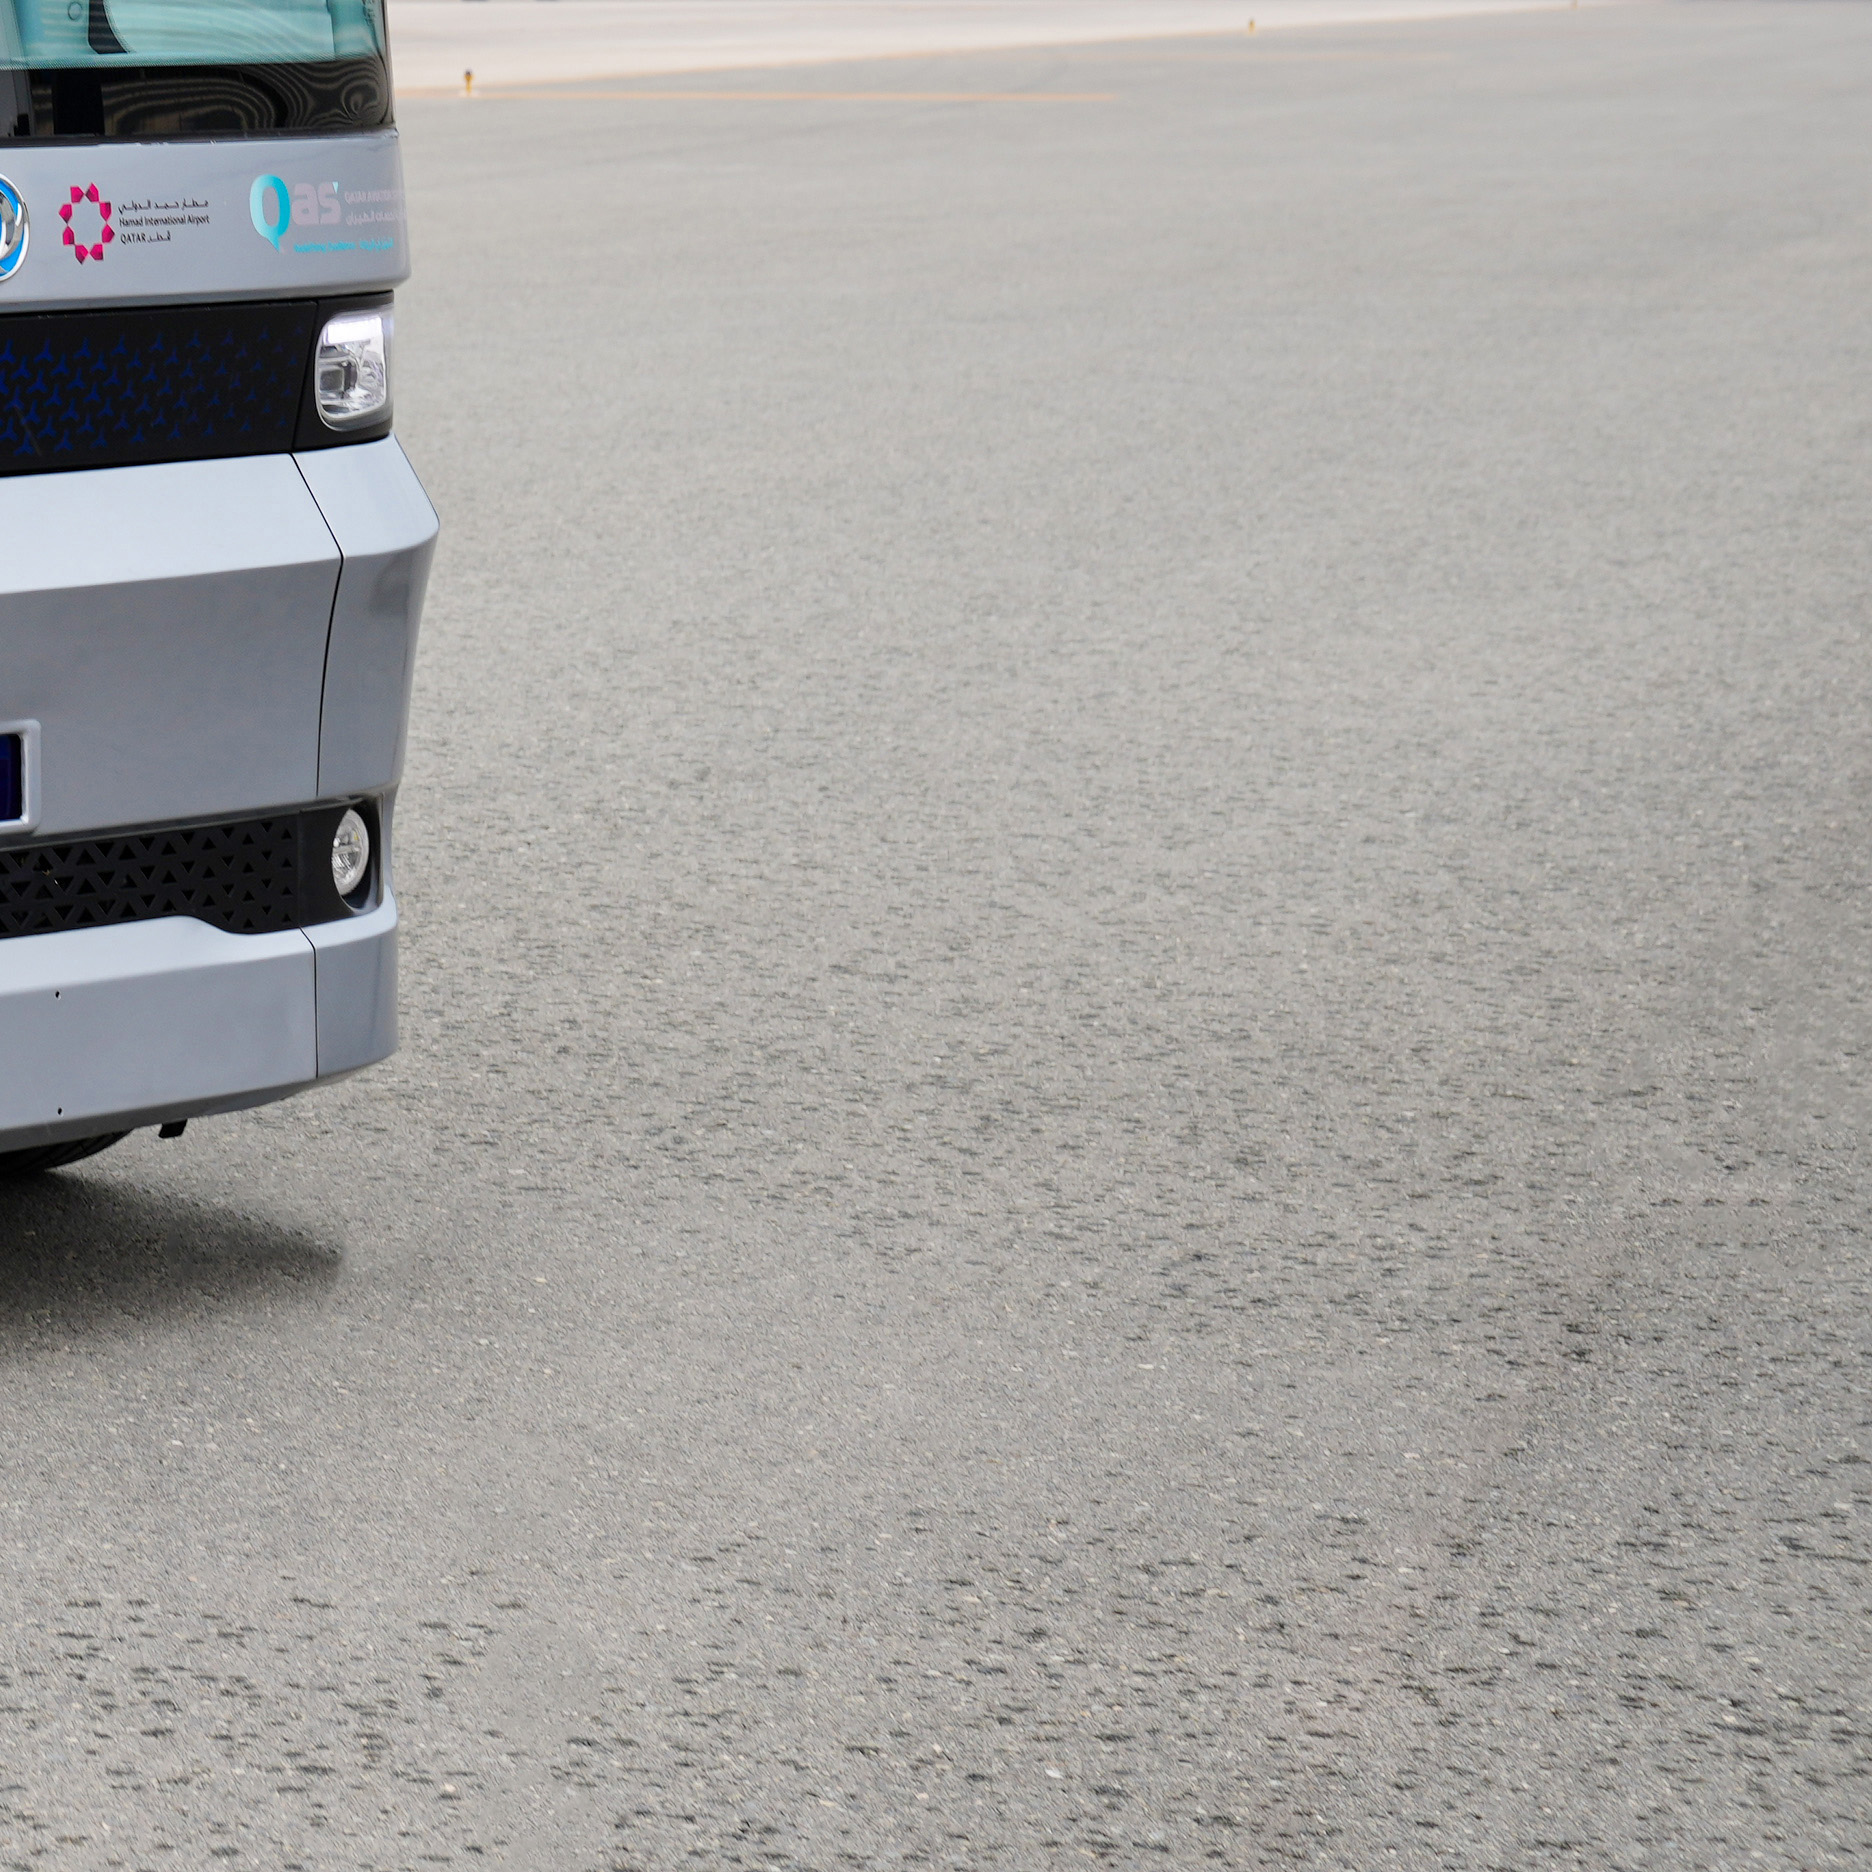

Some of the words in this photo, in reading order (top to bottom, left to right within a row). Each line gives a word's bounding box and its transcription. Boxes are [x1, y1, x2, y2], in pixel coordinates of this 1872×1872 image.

[119, 215, 143, 227] Hamad
[144, 214, 186, 227] International
[187, 213, 210, 226] Airport
[120, 232, 146, 245] QATAR
